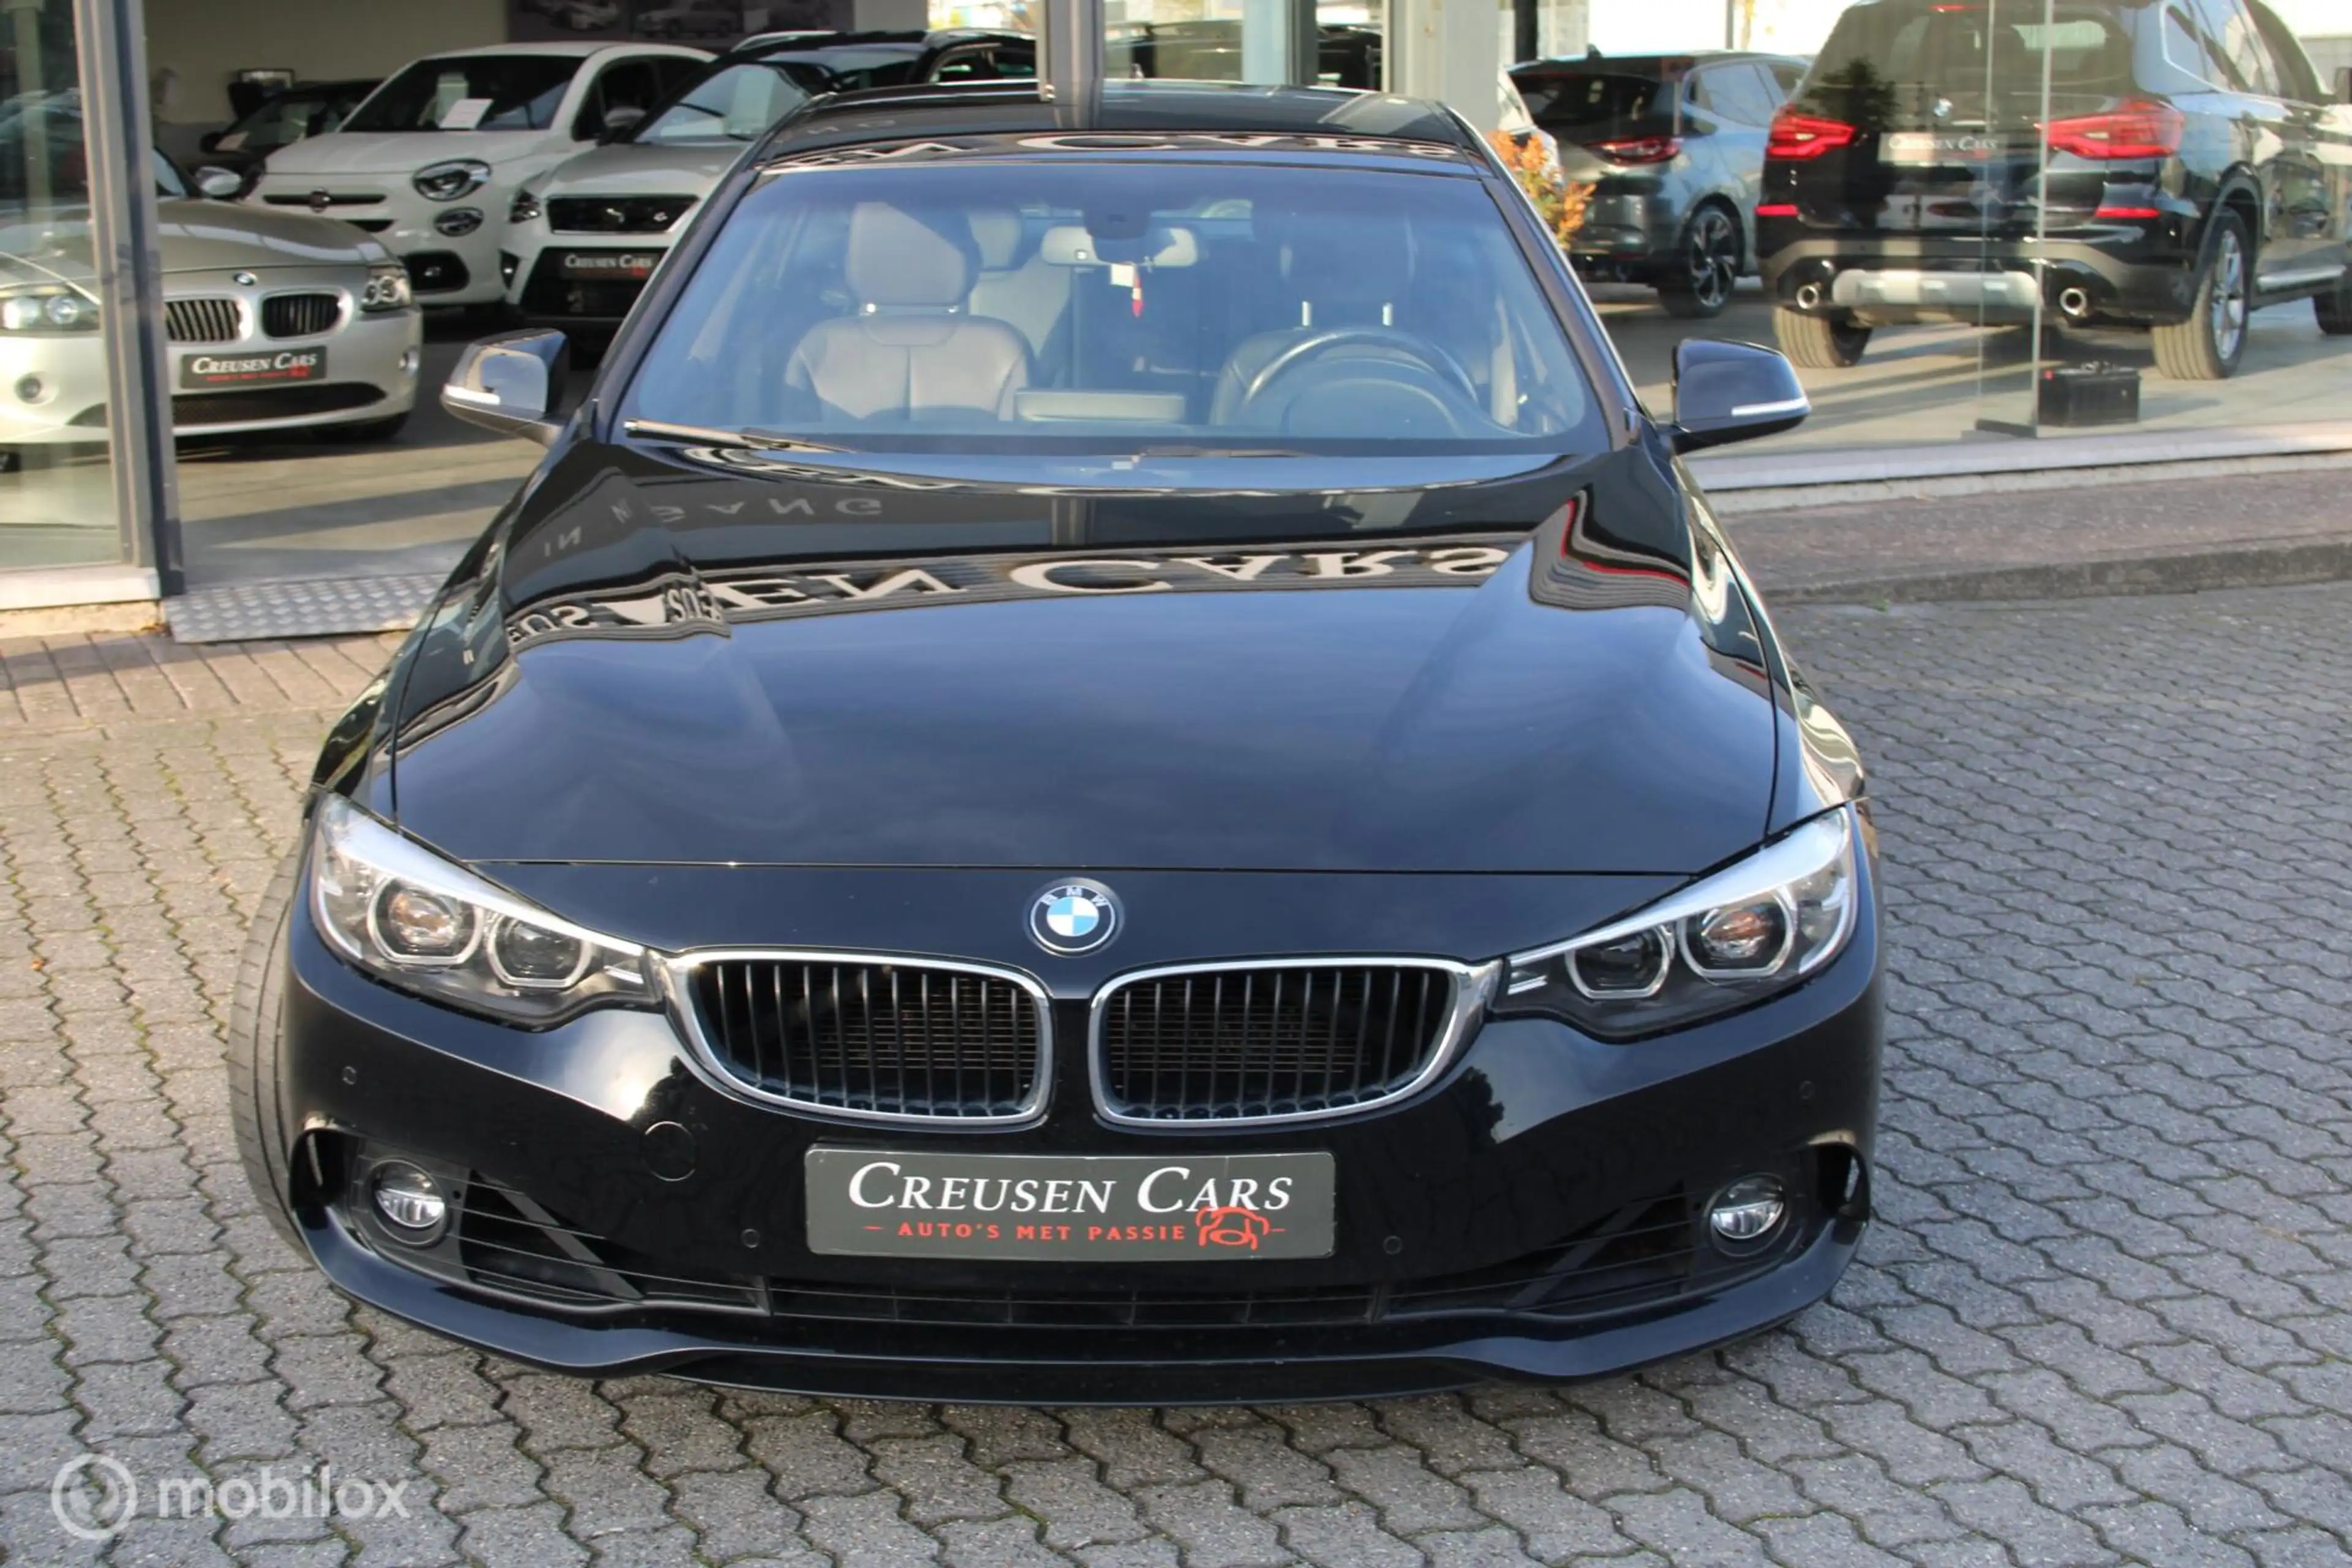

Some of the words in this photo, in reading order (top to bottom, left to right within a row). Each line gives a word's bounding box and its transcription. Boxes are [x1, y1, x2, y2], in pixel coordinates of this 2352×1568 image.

[192, 356, 271, 374] CREUSEN
[274, 352, 318, 370] CARS
[848, 1161, 1118, 1214] CREUSEN
[1137, 1166, 1293, 1213] CARS
[897, 1221, 1001, 1239] AUTO'S
[1016, 1226, 1071, 1241] MET
[1087, 1225, 1186, 1242] PASSIE
